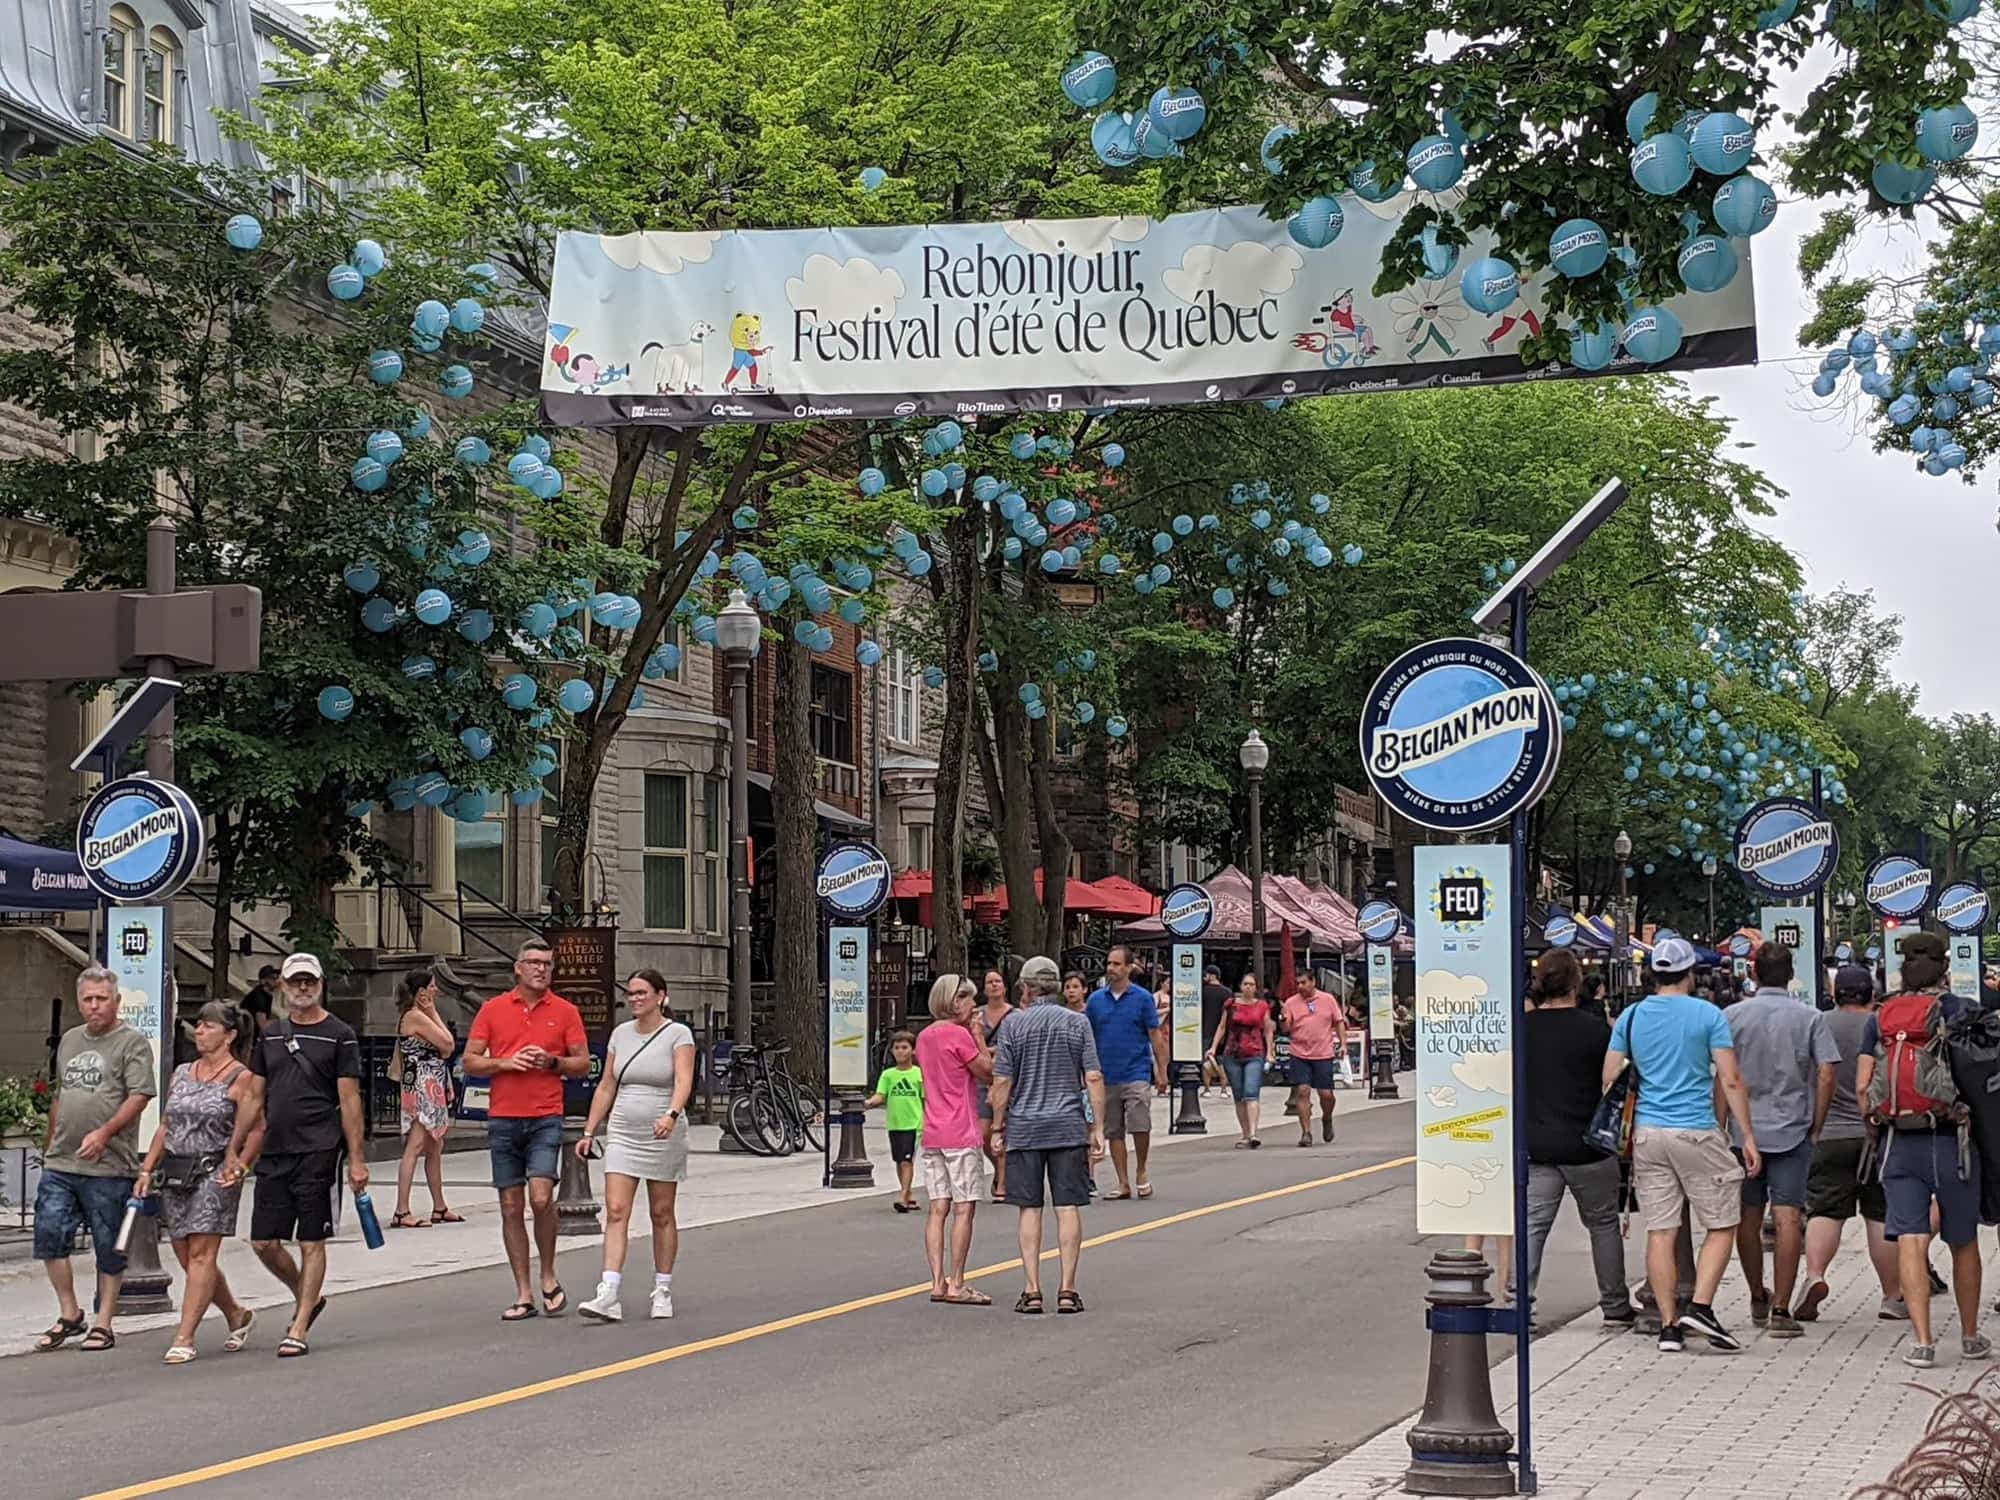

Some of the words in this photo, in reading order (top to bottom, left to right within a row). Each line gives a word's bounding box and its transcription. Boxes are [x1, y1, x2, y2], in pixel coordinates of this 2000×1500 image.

[1577, 232, 1600, 247] MOON
[1693, 241, 1715, 255] MOON
[922, 240, 1144, 305] Rebonjour,
[792, 300, 940, 363] Festival
[955, 300, 1042, 358] d'été
[1055, 297, 1106, 354] de
[1118, 289, 1279, 363] Québec
[1350, 380, 1385, 391] Québec
[1442, 372, 1480, 384] Canada
[808, 406, 853, 417] Desjardins
[1408, 664, 1420, 676] EN
[1421, 652, 1466, 668] AMÉRIQUE
[1470, 654, 1482, 665] DU
[1484, 659, 1508, 677] NORD
[1374, 713, 1469, 773] BELGIAN
[1471, 694, 1535, 736] MOON
[1403, 790, 1430, 811] BIÈRE
[1433, 804, 1446, 814] DE
[1450, 804, 1468, 815] BLÉ
[1472, 802, 1485, 812] DE
[1487, 782, 1514, 807] STYLE
[1514, 753, 1533, 783] BELGE
[87, 826, 139, 867] BELGIAN
[140, 811, 176, 840] MOON
[1741, 835, 1792, 868] BELGIAN
[1793, 825, 1829, 848] MOON
[32, 867, 66, 891] BELGIAN
[67, 872, 89, 890] MOON
[819, 870, 857, 895] BELGIAN
[857, 863, 883, 881] MOON
[1870, 879, 1905, 901] BELGIAN
[1904, 871, 1930, 887] MOON
[1446, 887, 1478, 916] FEQ
[1965, 895, 1985, 908] MOON
[126, 933, 145, 952] FEQ
[1778, 929, 1797, 945] FEQ
[557, 943, 604, 954] HÂTEAU
[560, 955, 604, 964] AURIER
[1421, 1015, 1473, 1034] Festival
[1475, 1014, 1507, 1034] d'été
[1426, 1035, 1444, 1053] de
[1447, 1034, 1502, 1056] Québec
